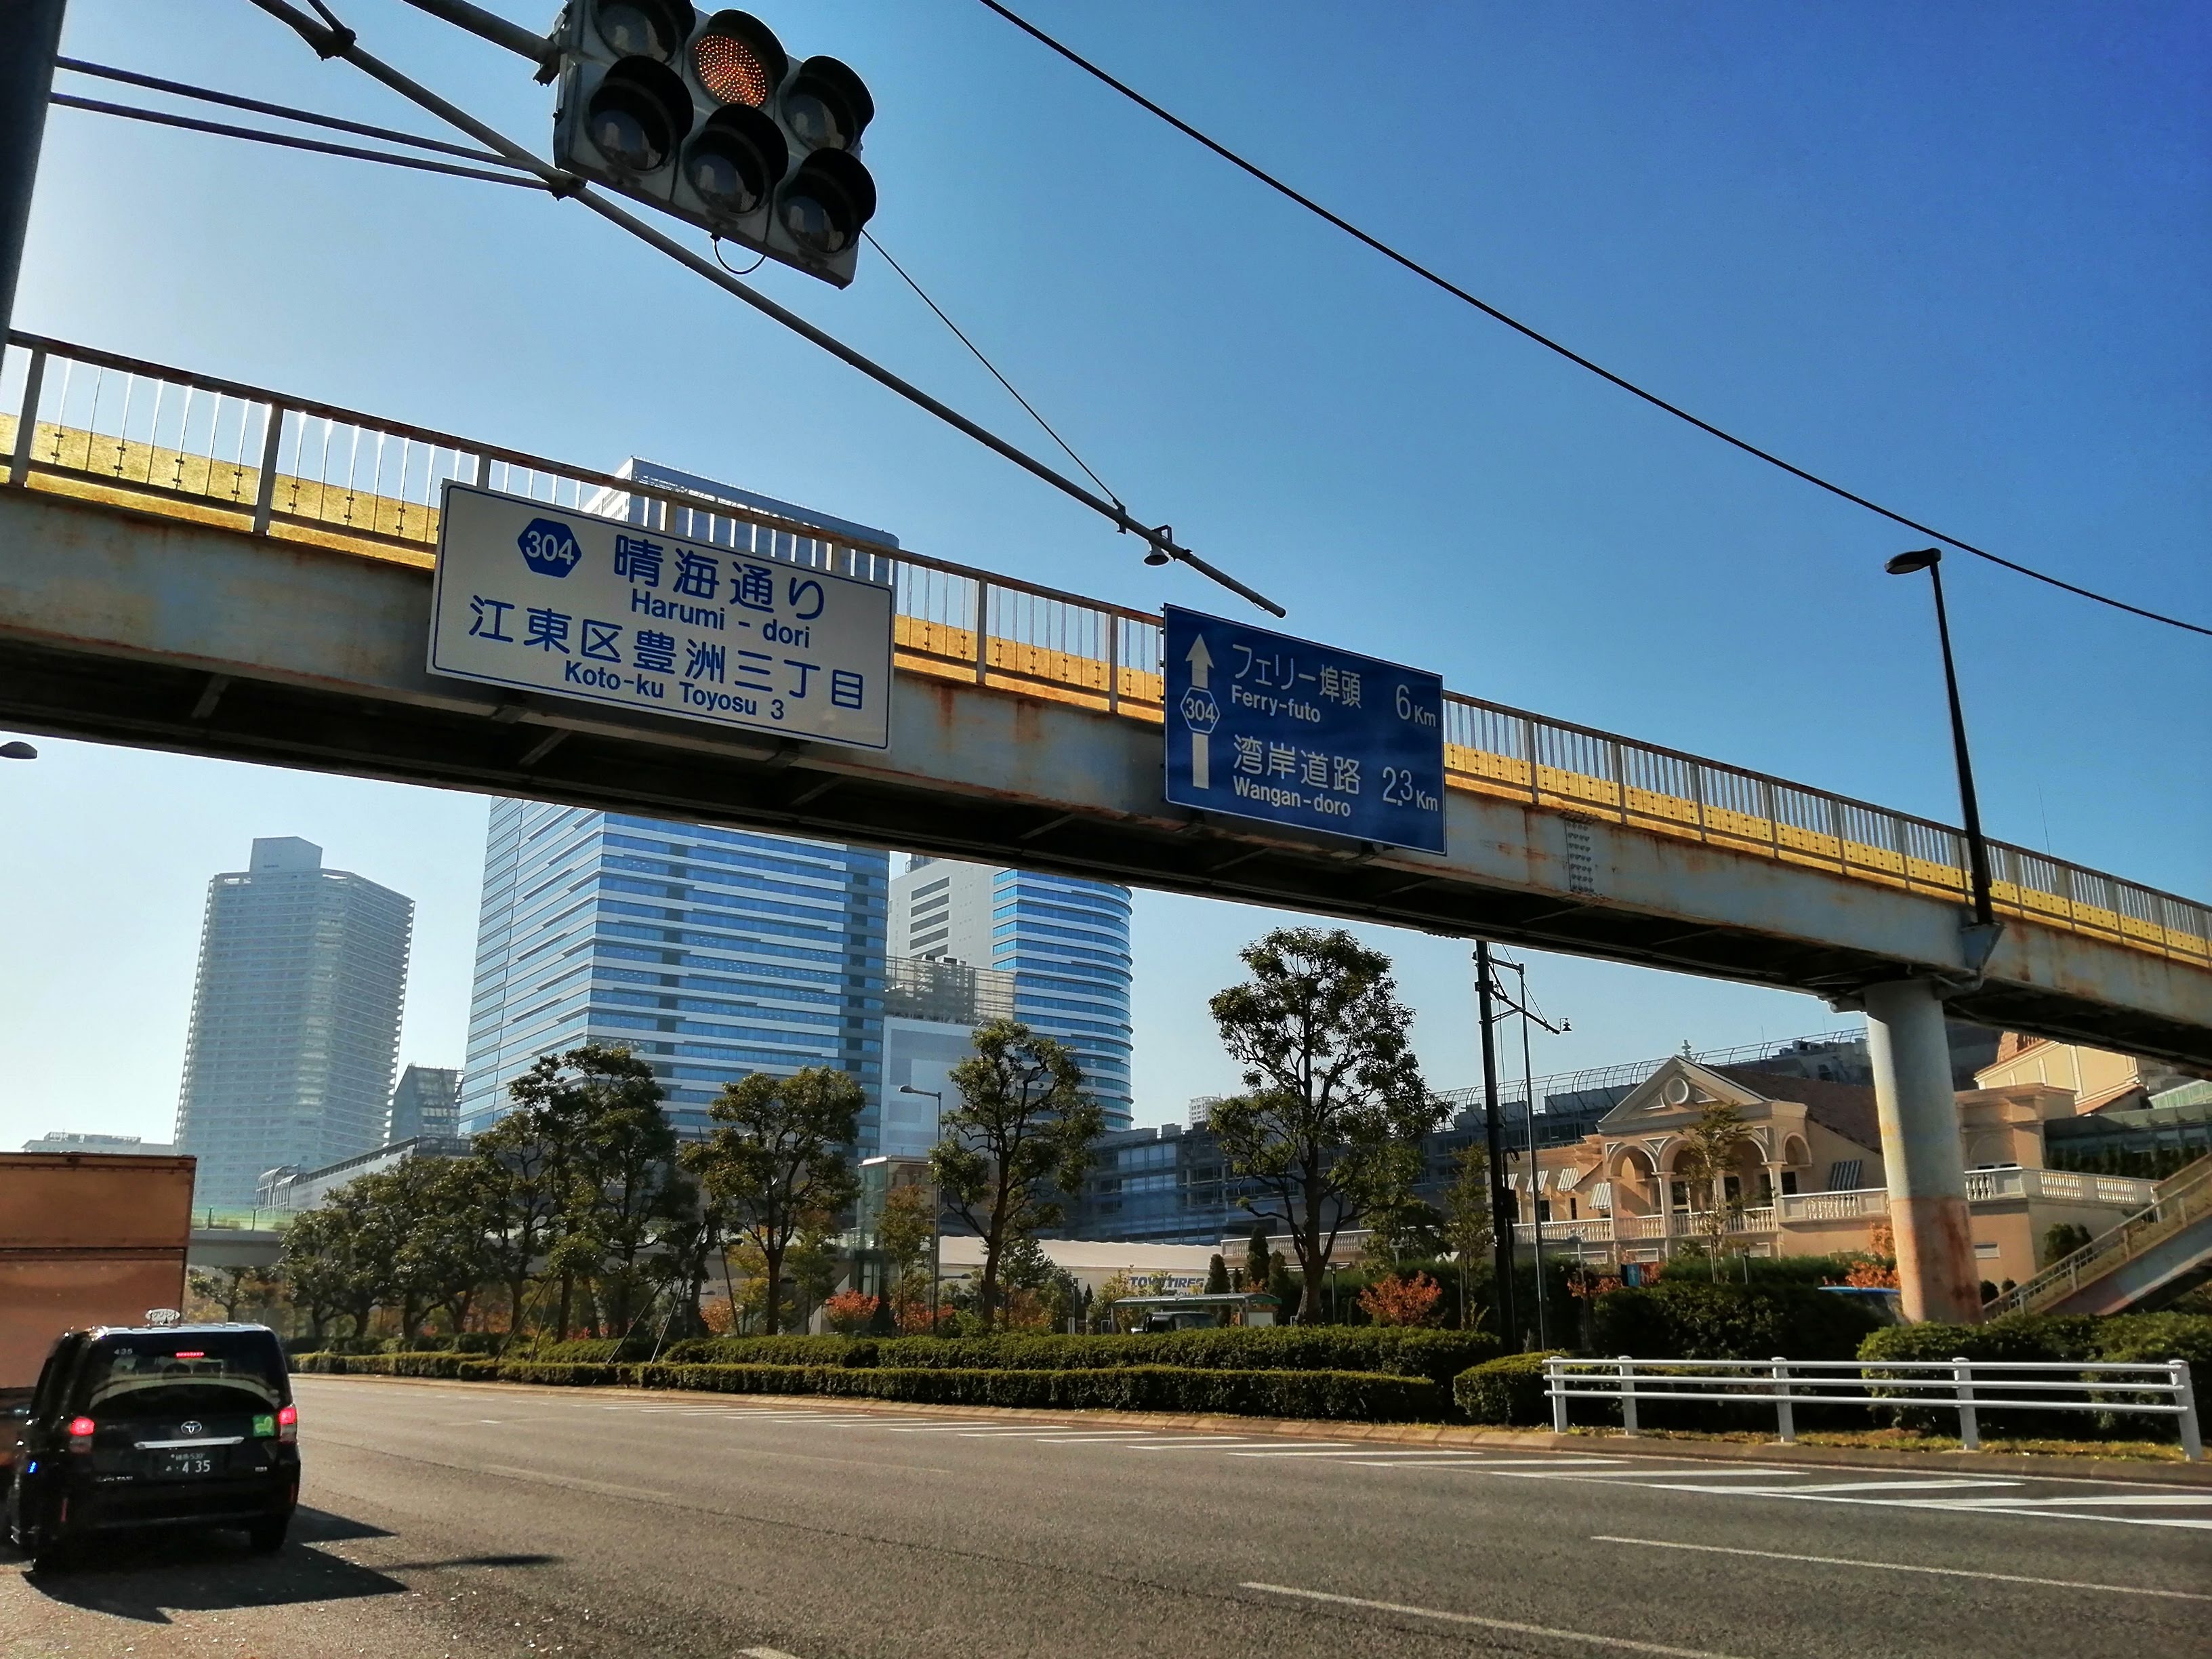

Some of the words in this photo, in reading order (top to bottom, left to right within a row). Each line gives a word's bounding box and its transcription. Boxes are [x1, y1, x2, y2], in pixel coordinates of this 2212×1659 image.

[525, 531, 576, 567] 304
[613, 534, 825, 621] 晴海通り
[631, 591, 725, 630] Harumi
[468, 594, 865, 711] 江東区豊洲三丁目
[1232, 643, 1361, 710] フェリー埠頭
[565, 661, 664, 699] Koto-ku
[679, 681, 757, 716] Toyosu
[771, 699, 785, 720] 3
[1185, 697, 1215, 724] 304
[1231, 684, 1321, 723] Ferry-futo
[1233, 733, 1361, 795] 湾岸道路
[1233, 775, 1351, 818] Wangan-doro
